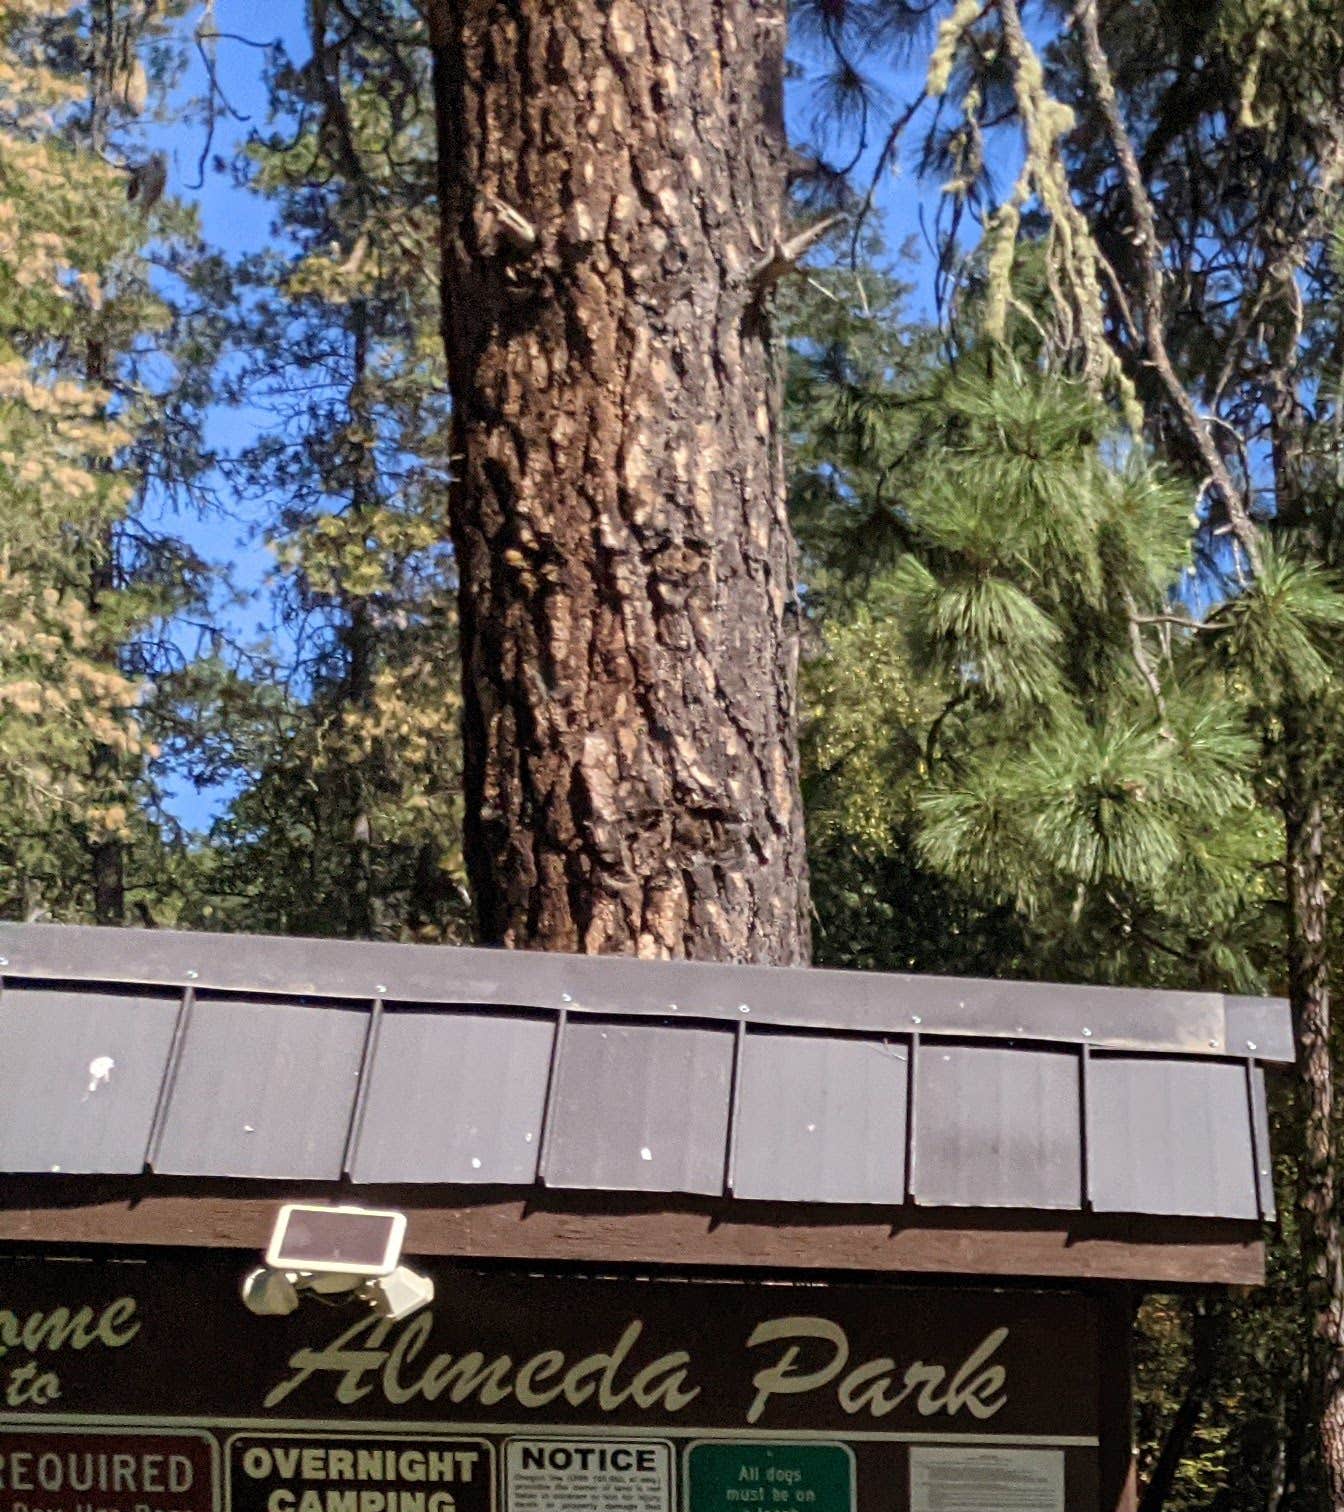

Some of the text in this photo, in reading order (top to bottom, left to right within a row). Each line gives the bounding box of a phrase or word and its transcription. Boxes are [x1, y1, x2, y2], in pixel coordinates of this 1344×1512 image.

[263, 1310, 1008, 1423] Almeda Park
[7, 1361, 62, 1406] to
[243, 1447, 478, 1484] OVERNIGHT
[522, 1448, 656, 1472] NOTICE
[738, 1466, 801, 1485] All dogs
[726, 1488, 816, 1502] must be on
